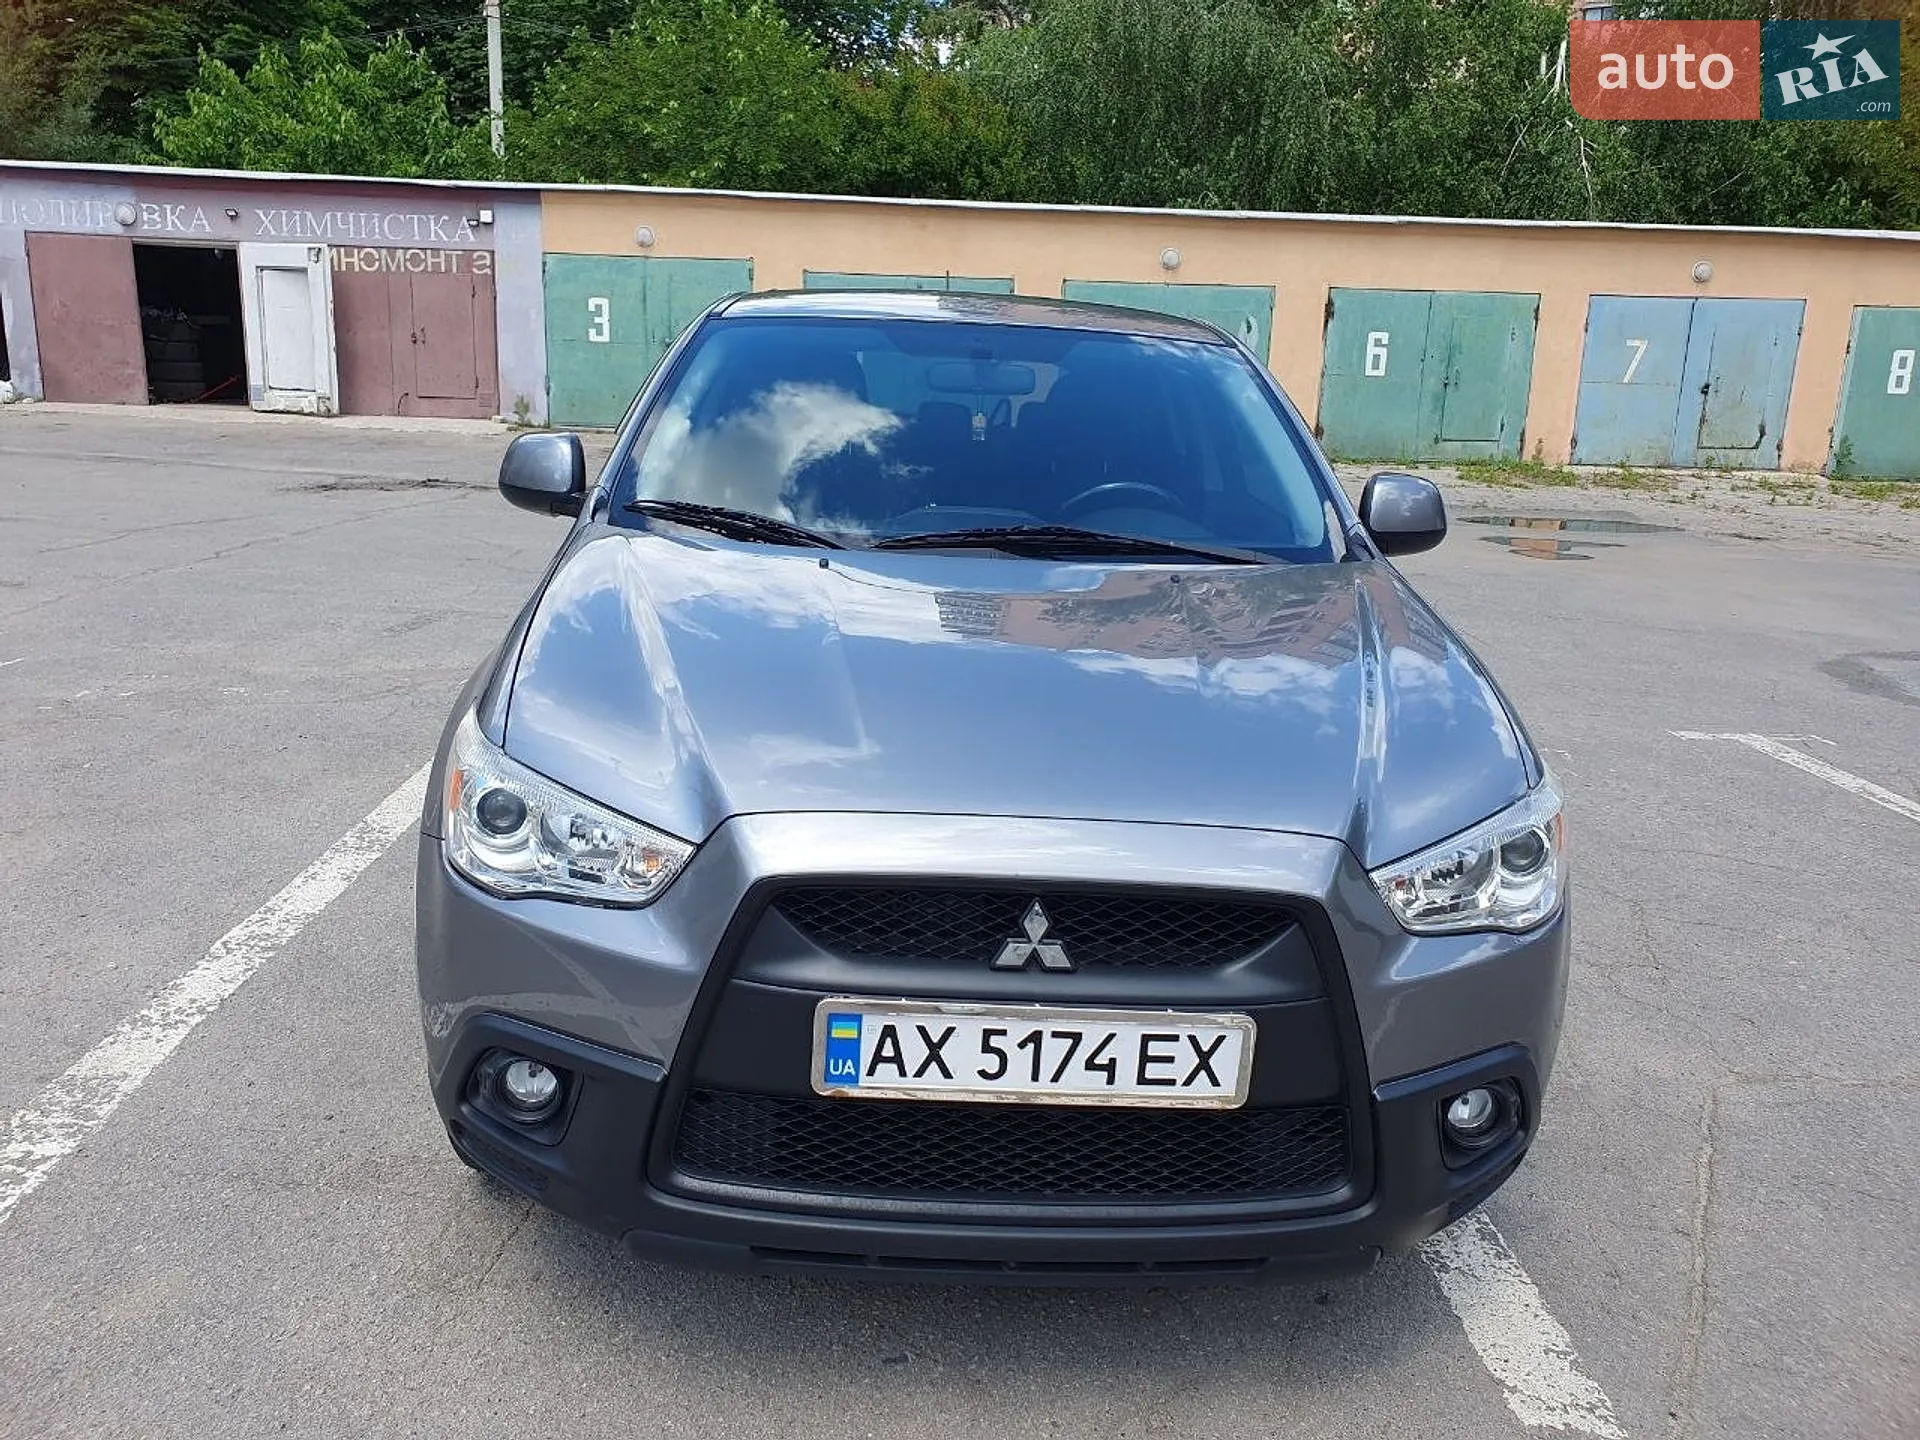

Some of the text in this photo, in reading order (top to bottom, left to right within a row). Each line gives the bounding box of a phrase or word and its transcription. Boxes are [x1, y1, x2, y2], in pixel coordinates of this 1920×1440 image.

[0, 198, 477, 242] ПОЛИРВКА ХИМЧИСТКА
[588, 297, 610, 342] 3
[1364, 331, 1389, 377] 6
[1622, 339, 1648, 384] 7
[1886, 349, 1915, 395] 8
[829, 1024, 1227, 1088] UA AX 5174 EX
